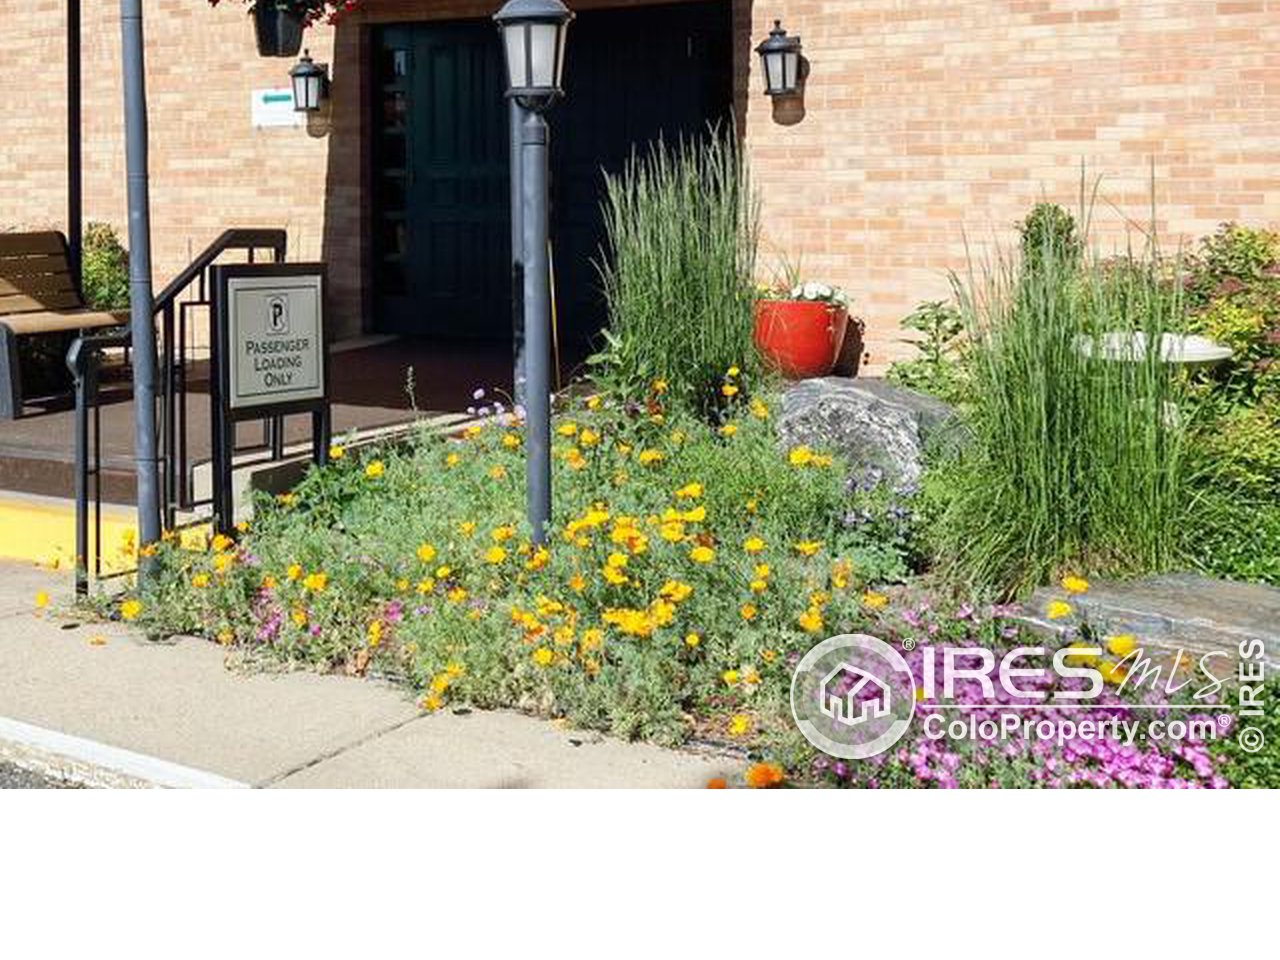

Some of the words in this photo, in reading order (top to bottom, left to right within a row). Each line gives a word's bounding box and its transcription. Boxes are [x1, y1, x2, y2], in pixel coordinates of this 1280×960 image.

[272, 303, 283, 326] P
[246, 338, 309, 354] PASSENGER
[254, 355, 302, 371] LOADING
[264, 372, 293, 387] ONLY
